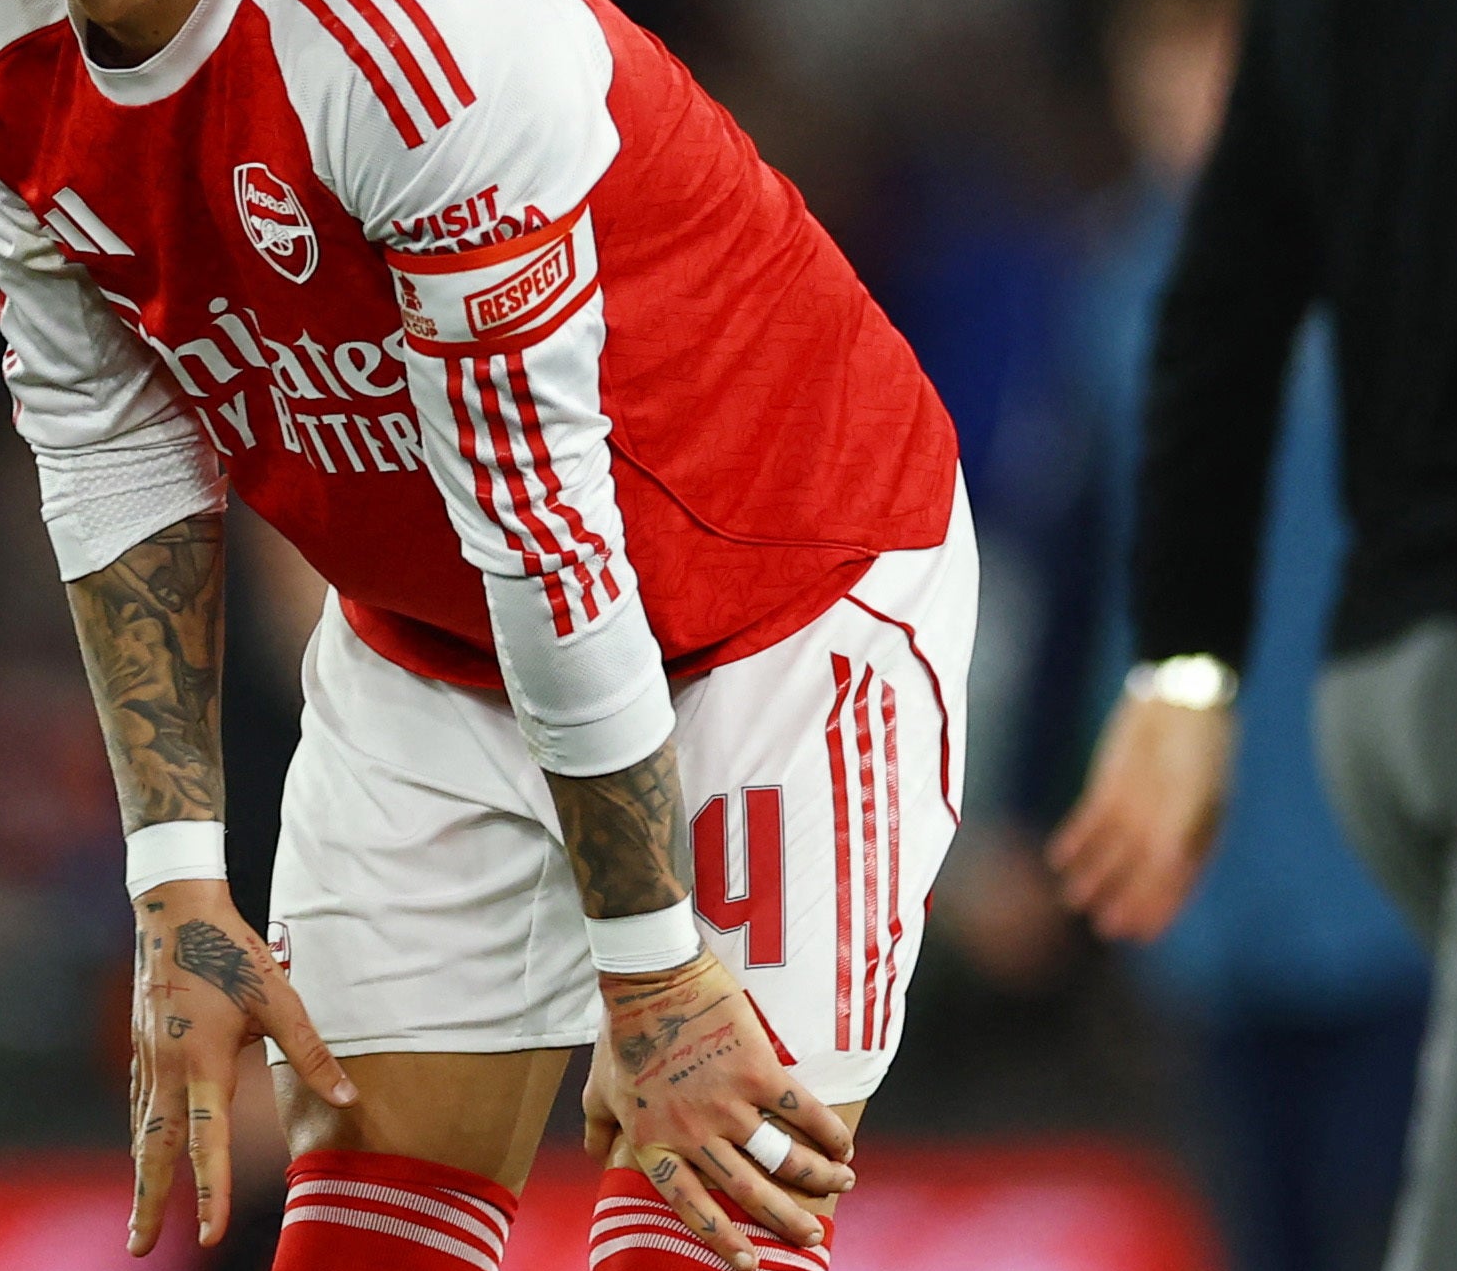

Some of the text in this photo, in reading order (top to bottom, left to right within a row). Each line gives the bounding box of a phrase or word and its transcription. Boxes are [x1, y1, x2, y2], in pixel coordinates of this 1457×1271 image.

[391, 184, 500, 242] VISIT
[477, 249, 564, 327] RESPECT
[689, 784, 786, 970] 4
